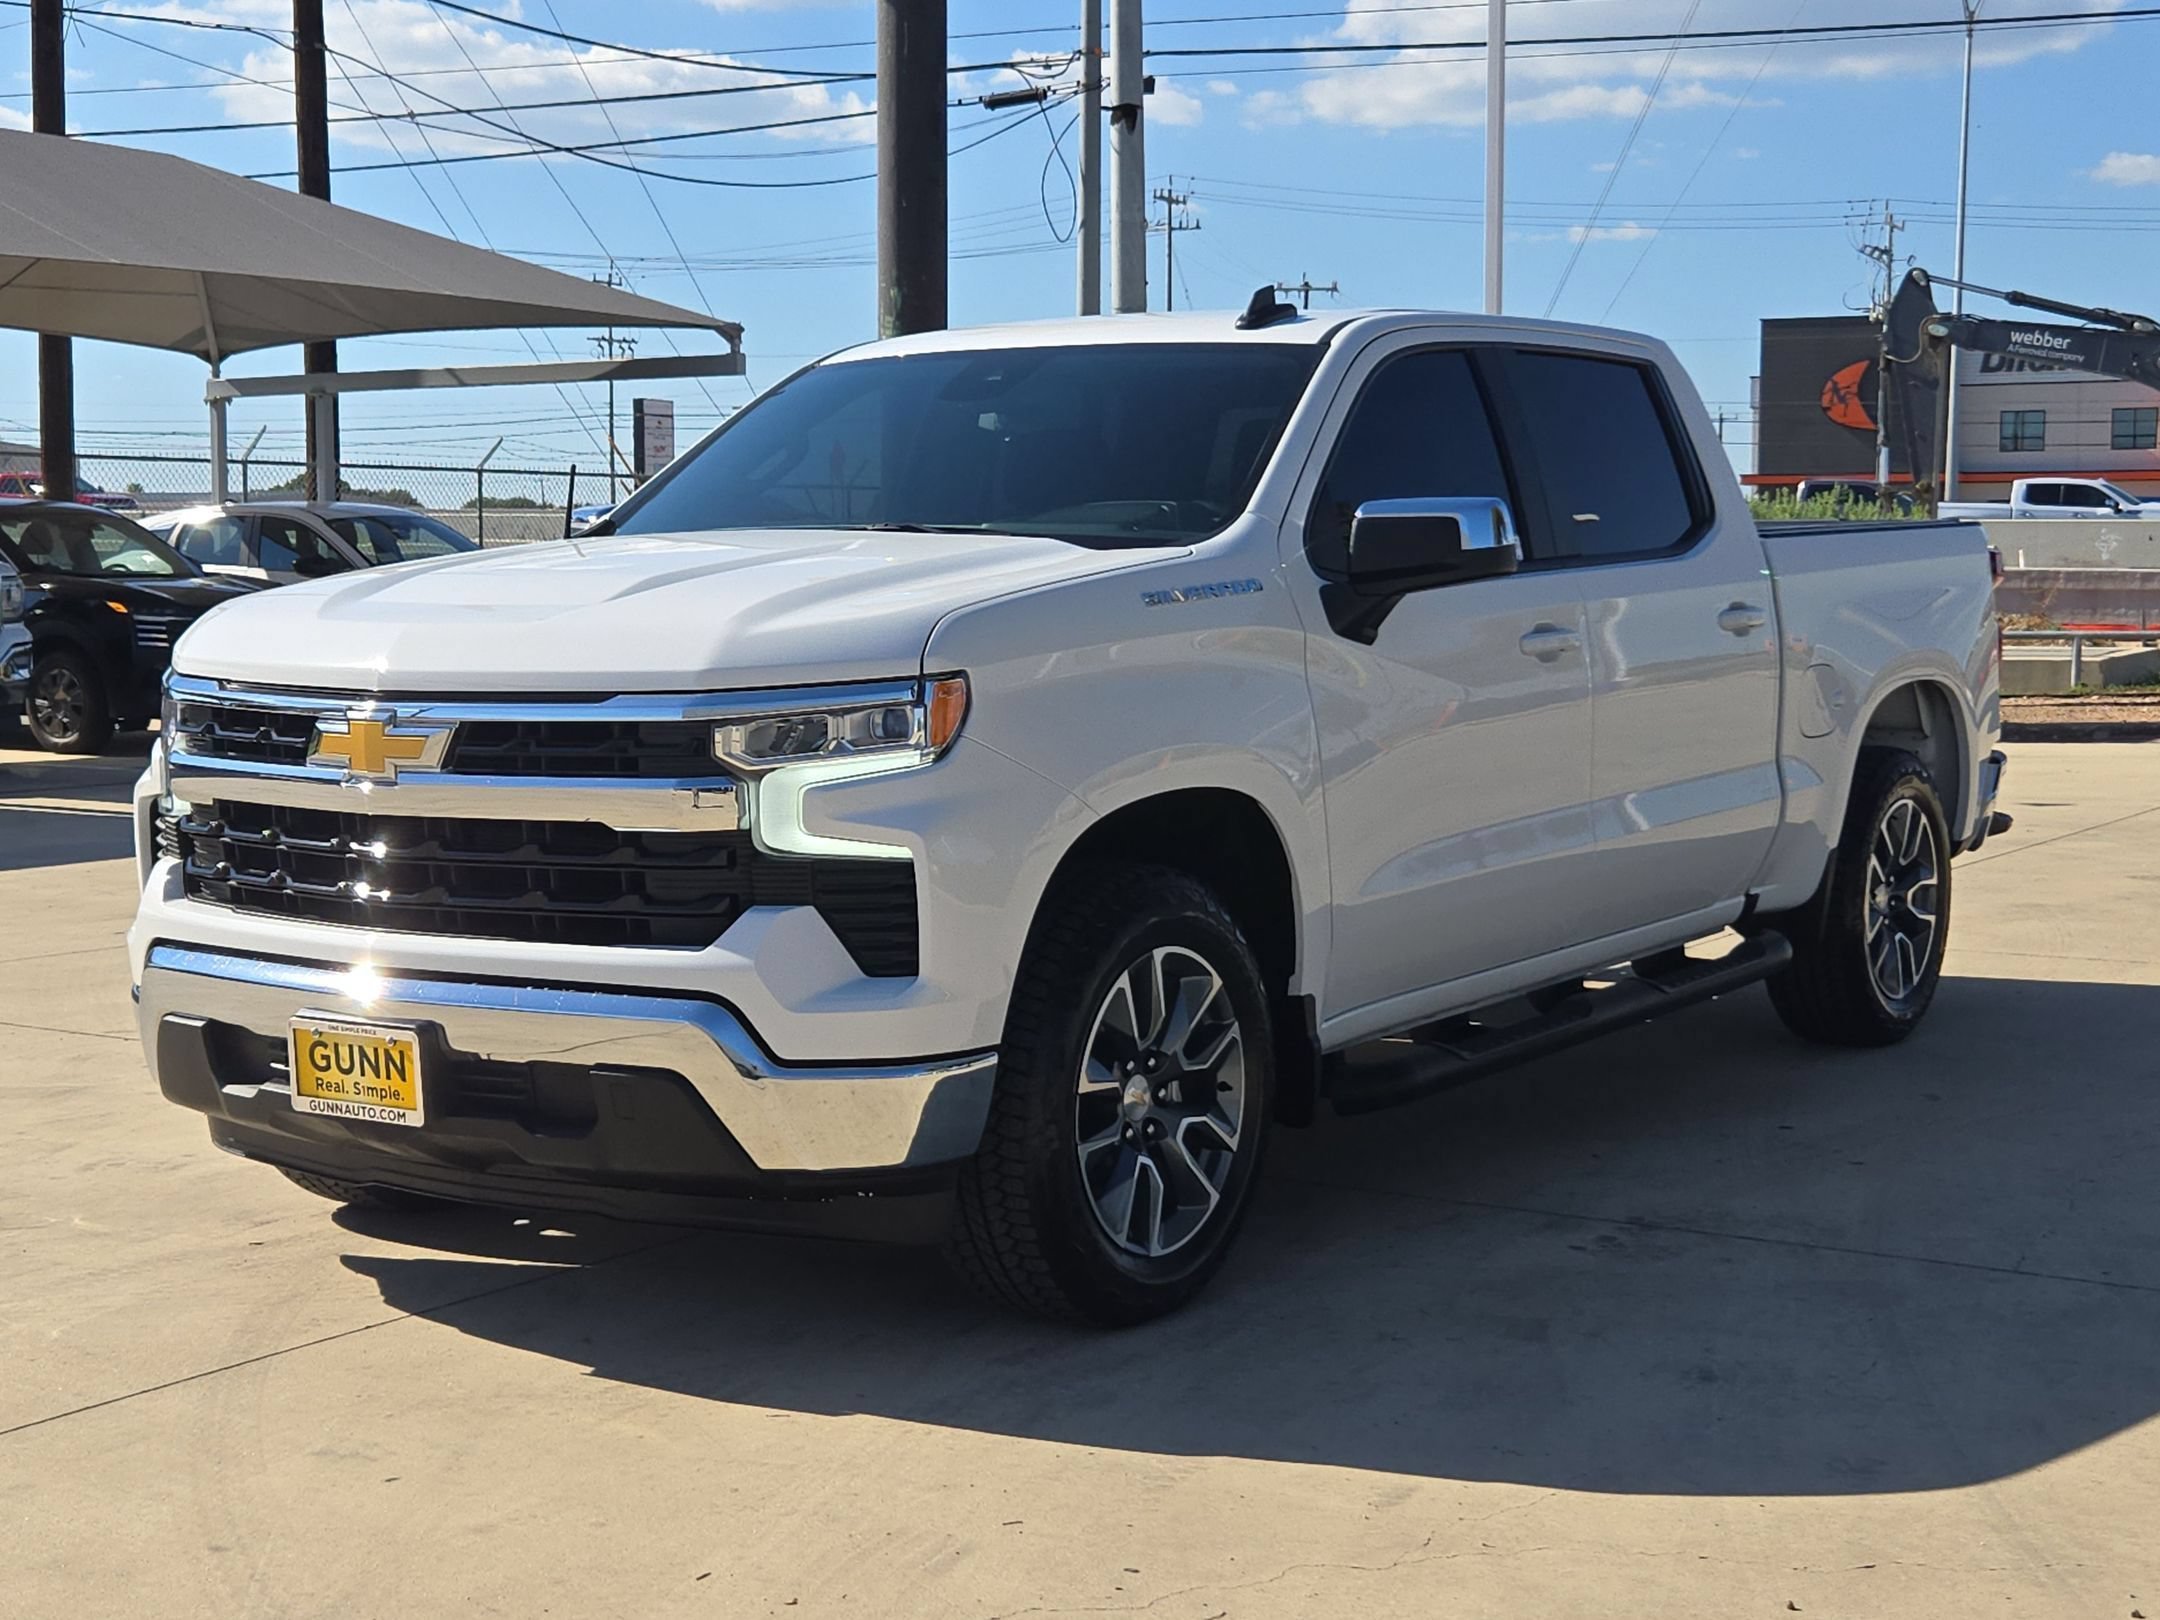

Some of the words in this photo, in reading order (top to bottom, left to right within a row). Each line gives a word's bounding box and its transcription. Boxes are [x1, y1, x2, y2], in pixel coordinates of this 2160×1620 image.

[2010, 330, 2072, 349] webber
[1140, 578, 1264, 607] SILVERADO
[308, 1040, 407, 1083] GUNN
[315, 1077, 349, 1094] Real.
[309, 1100, 407, 1123] GUNNAUTO.COM
